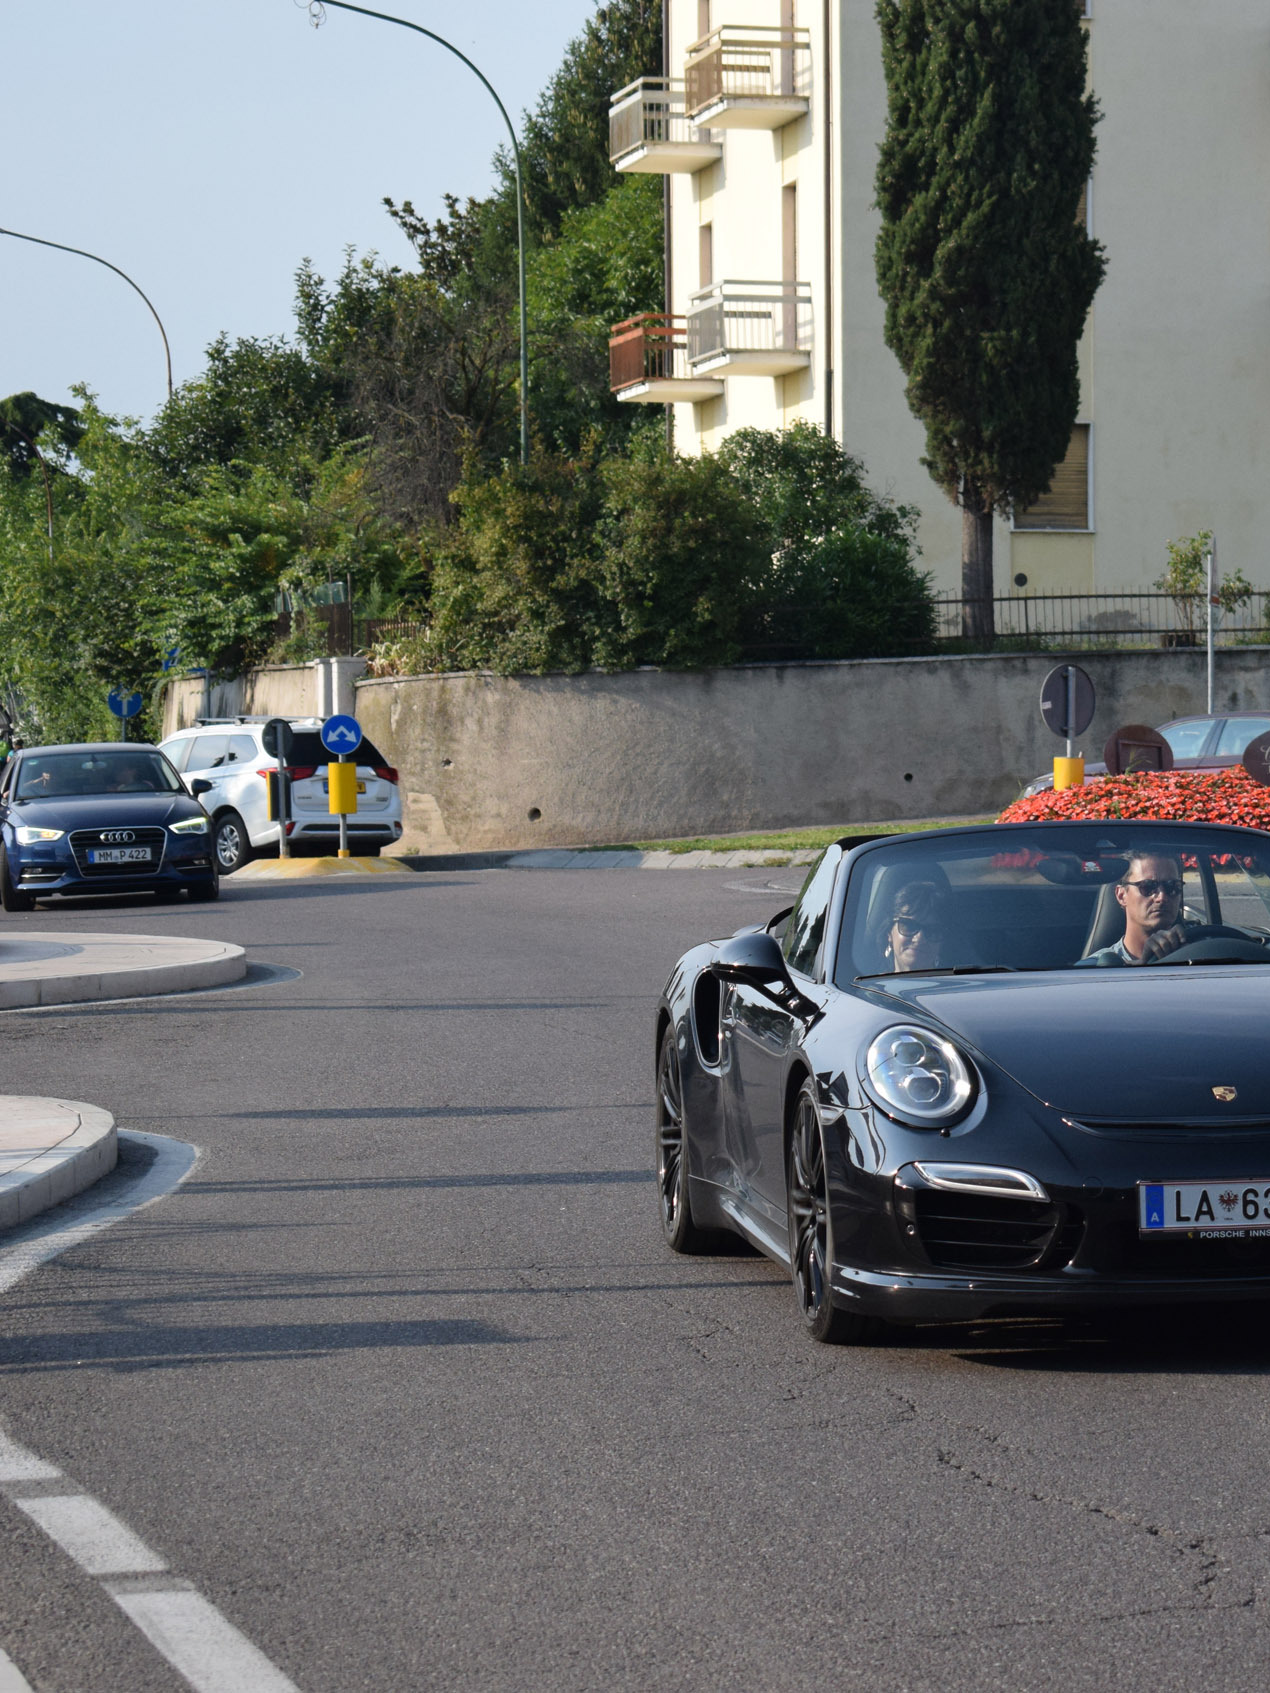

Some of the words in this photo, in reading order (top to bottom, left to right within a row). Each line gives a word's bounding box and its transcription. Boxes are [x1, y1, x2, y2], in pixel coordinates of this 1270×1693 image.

[98, 851, 113, 861] MM
[119, 850, 126, 861] P
[128, 849, 147, 860] 422
[1175, 1189, 1216, 1223] LA
[1151, 1212, 1160, 1223] A
[1200, 1230, 1245, 1239] PORSCHE
